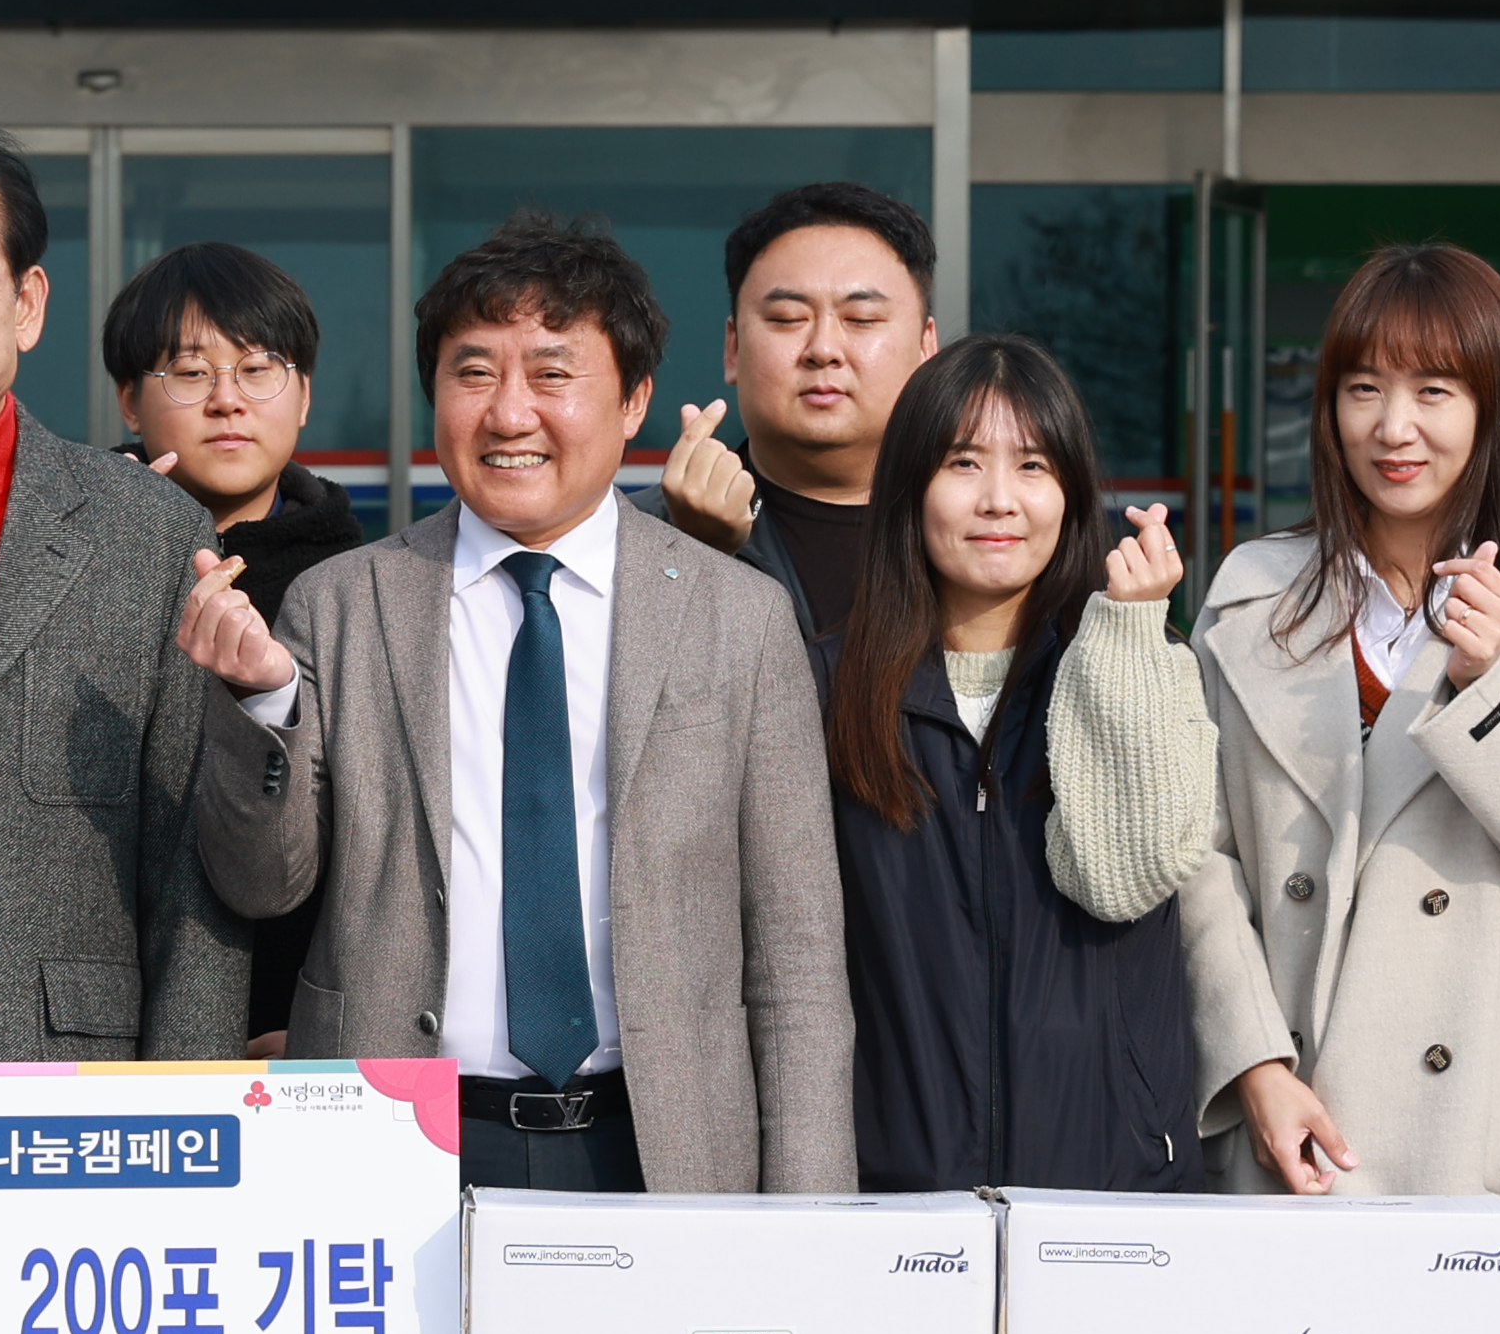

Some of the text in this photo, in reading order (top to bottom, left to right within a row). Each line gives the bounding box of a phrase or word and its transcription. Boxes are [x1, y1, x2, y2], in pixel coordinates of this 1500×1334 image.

[509, 1250, 611, 1263] www.jindomg.com
[1045, 1247, 1147, 1260] www.jindomg.com
[889, 1254, 954, 1273] Jindo
[1428, 1254, 1494, 1273] Jindo
